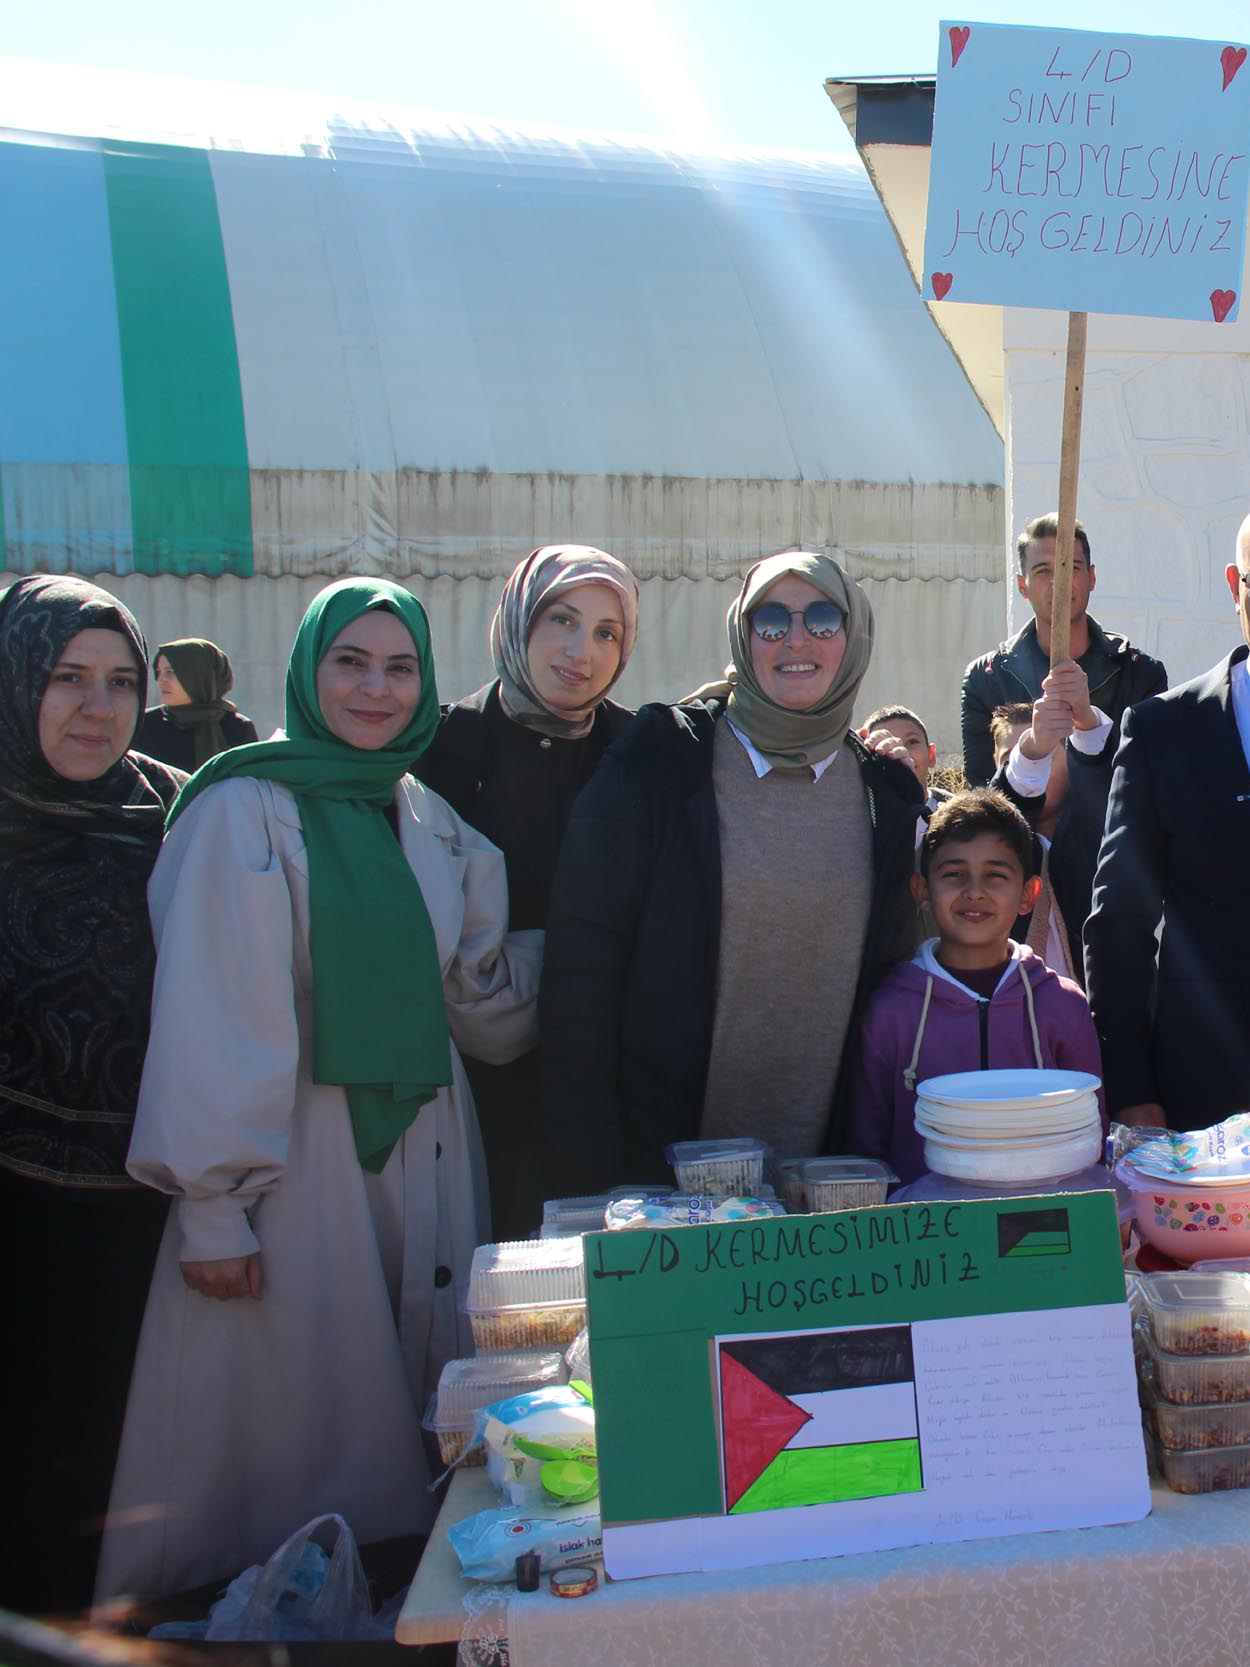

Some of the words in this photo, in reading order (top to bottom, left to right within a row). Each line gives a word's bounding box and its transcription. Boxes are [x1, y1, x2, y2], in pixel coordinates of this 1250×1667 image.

[1046, 47, 1132, 82] 4/D
[1003, 88, 1115, 126] SINIFI
[982, 140, 1246, 200] KERMESİNE
[944, 209, 1027, 258] HOŞ
[1040, 212, 1231, 258] GELDİNİZ
[593, 1232, 680, 1282] 4/D
[695, 1206, 962, 1273] KERMESİMİZE
